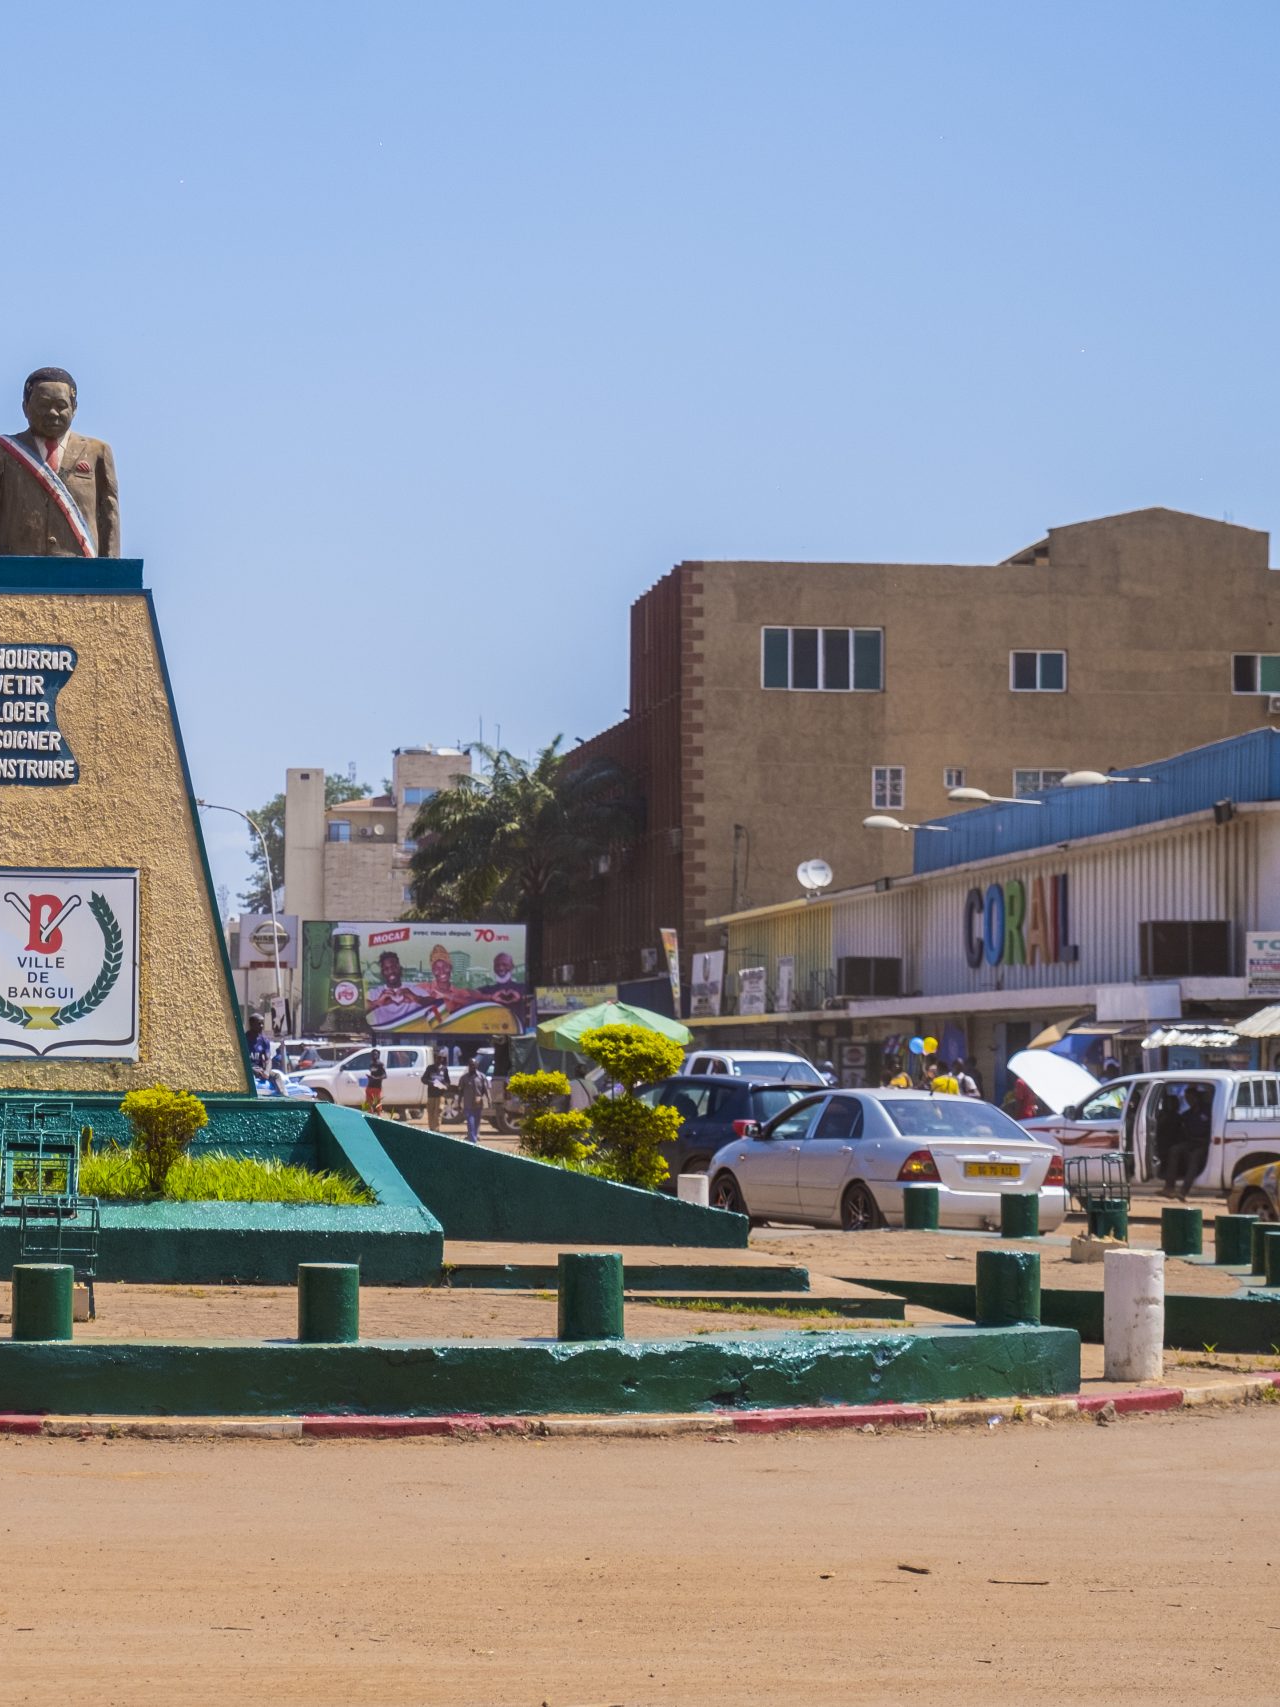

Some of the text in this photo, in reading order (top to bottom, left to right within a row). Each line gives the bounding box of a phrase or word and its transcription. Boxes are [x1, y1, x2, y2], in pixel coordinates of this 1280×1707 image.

[372, 930, 406, 944] MOCAF
[474, 929, 495, 942] 70
[17, 956, 65, 969] VILLE
[27, 972, 49, 984] DE
[8, 986, 74, 999] BANGUI
